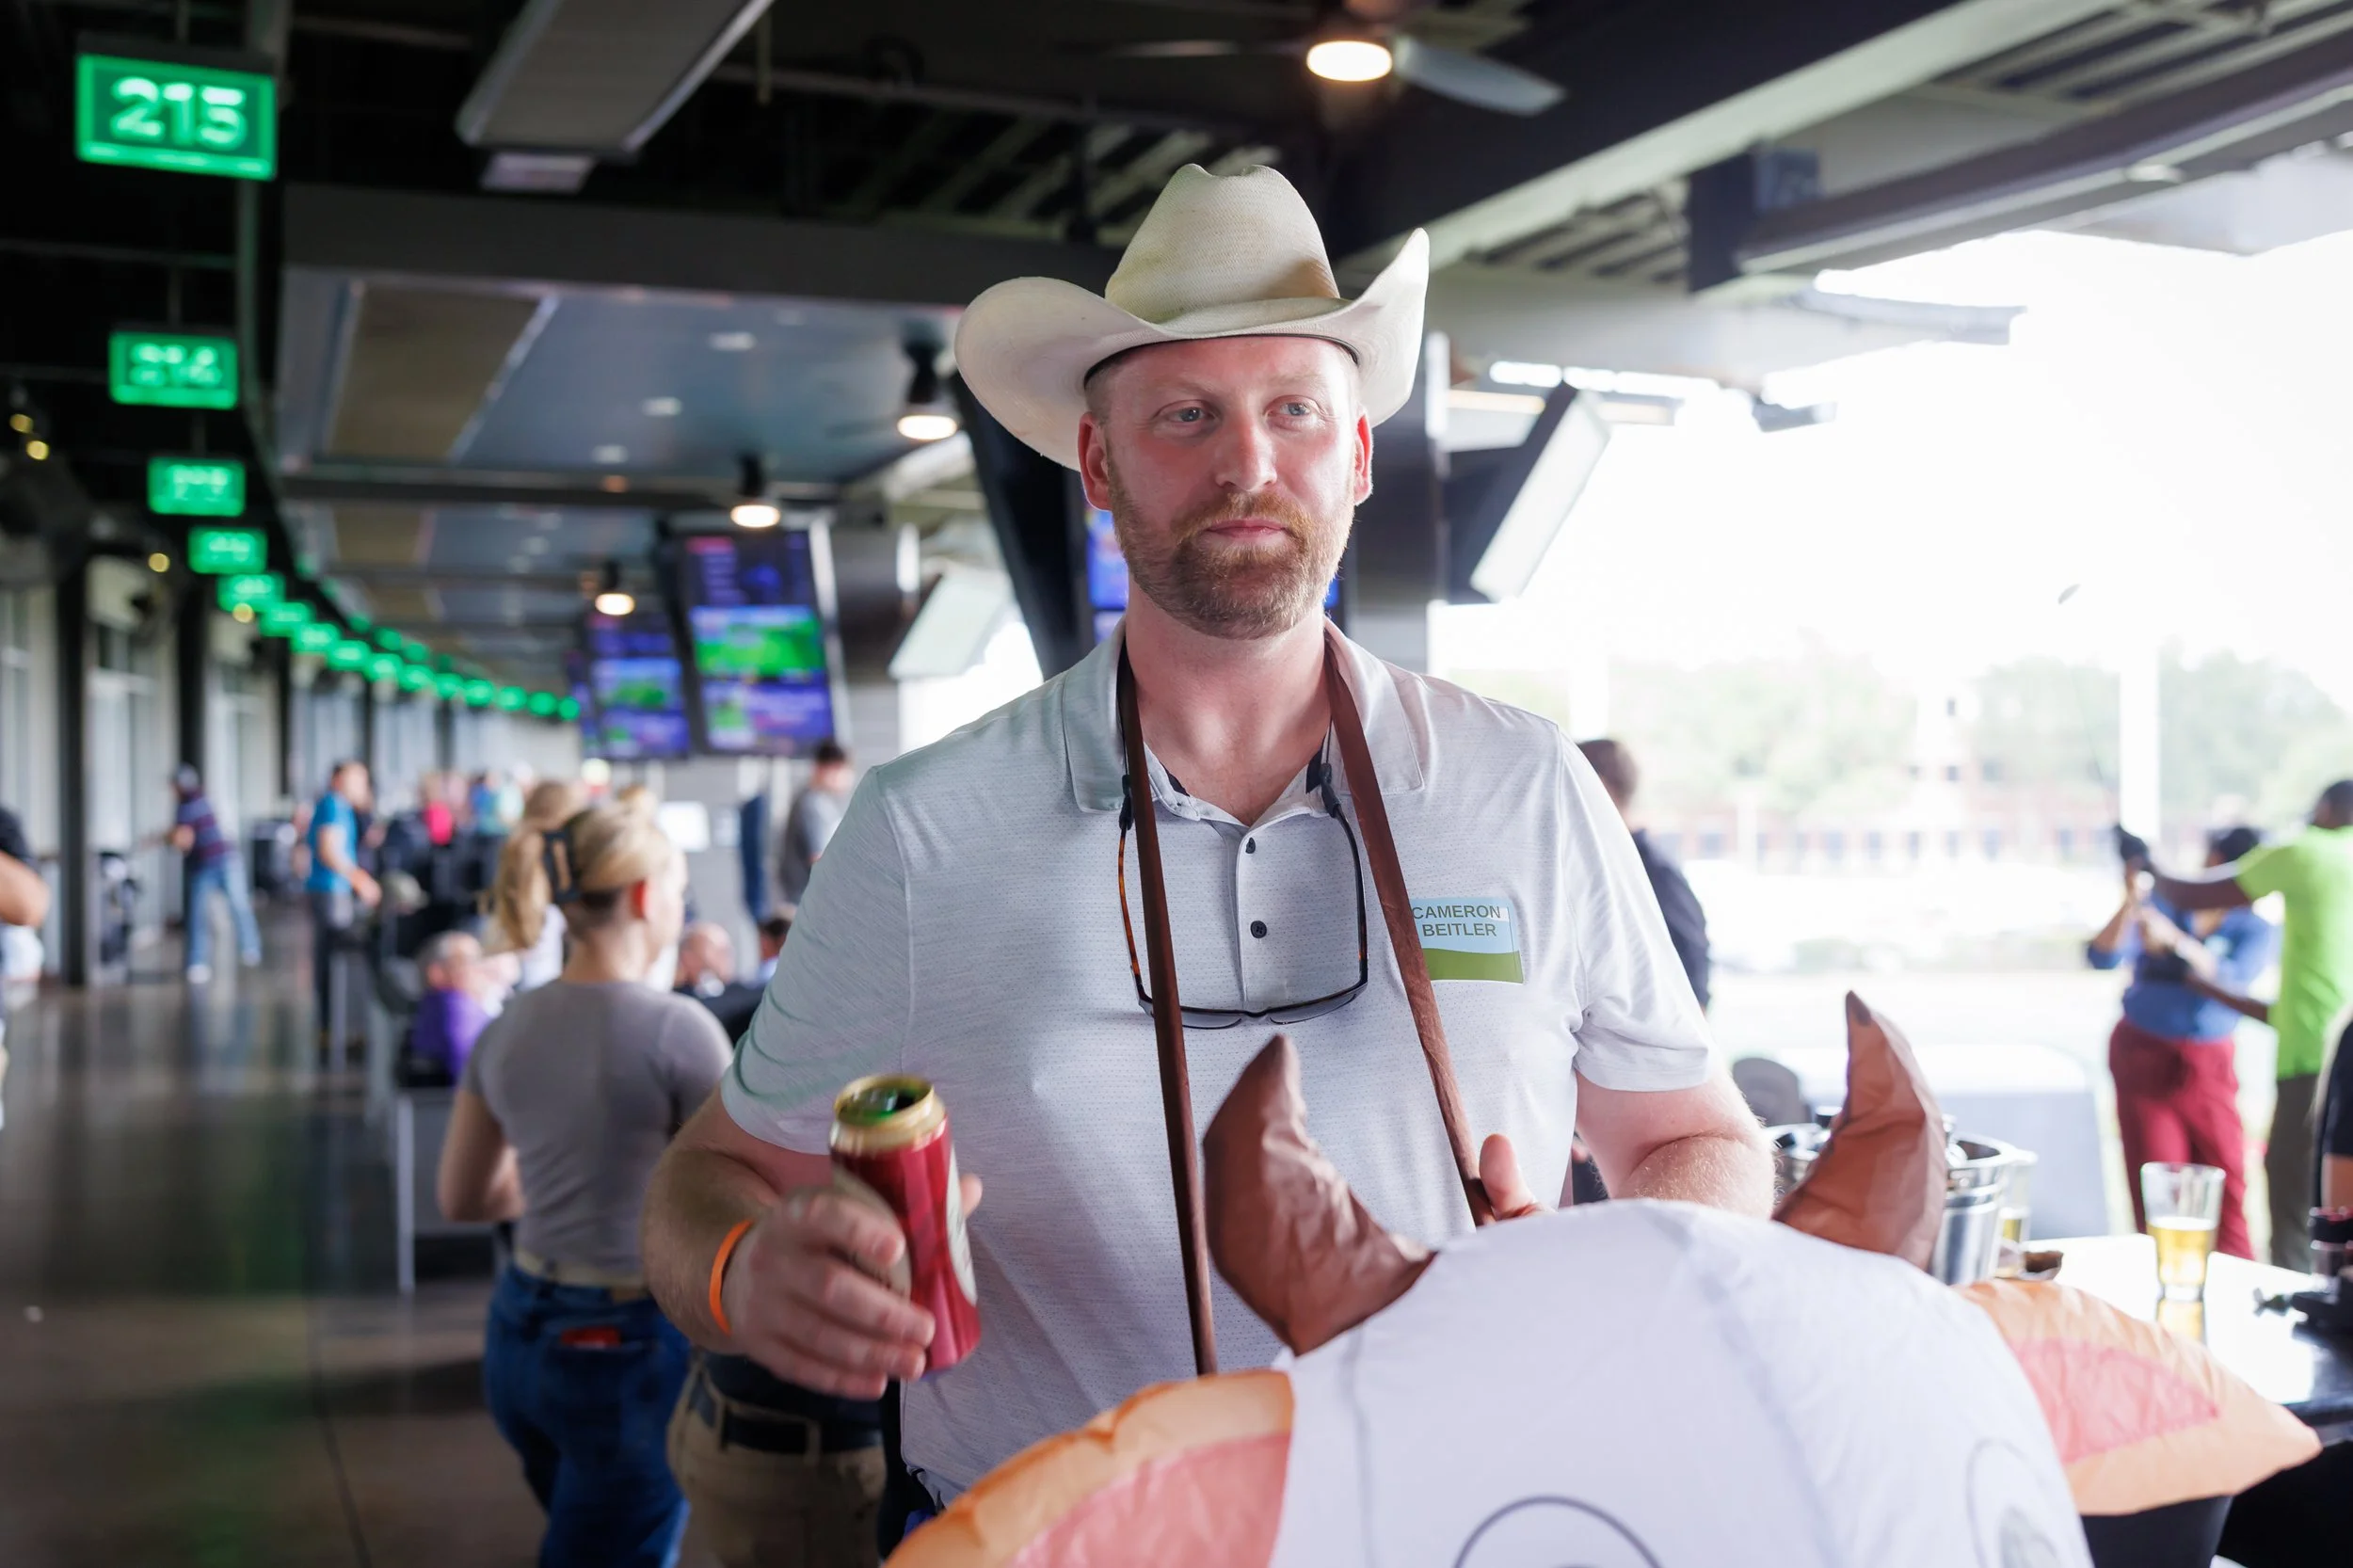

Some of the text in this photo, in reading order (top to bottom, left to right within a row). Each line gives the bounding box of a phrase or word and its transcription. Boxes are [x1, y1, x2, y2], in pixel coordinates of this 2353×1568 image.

[110, 75, 247, 151] 215
[1413, 904, 1501, 919] CAMERON
[1422, 922, 1497, 936] BEITLER
